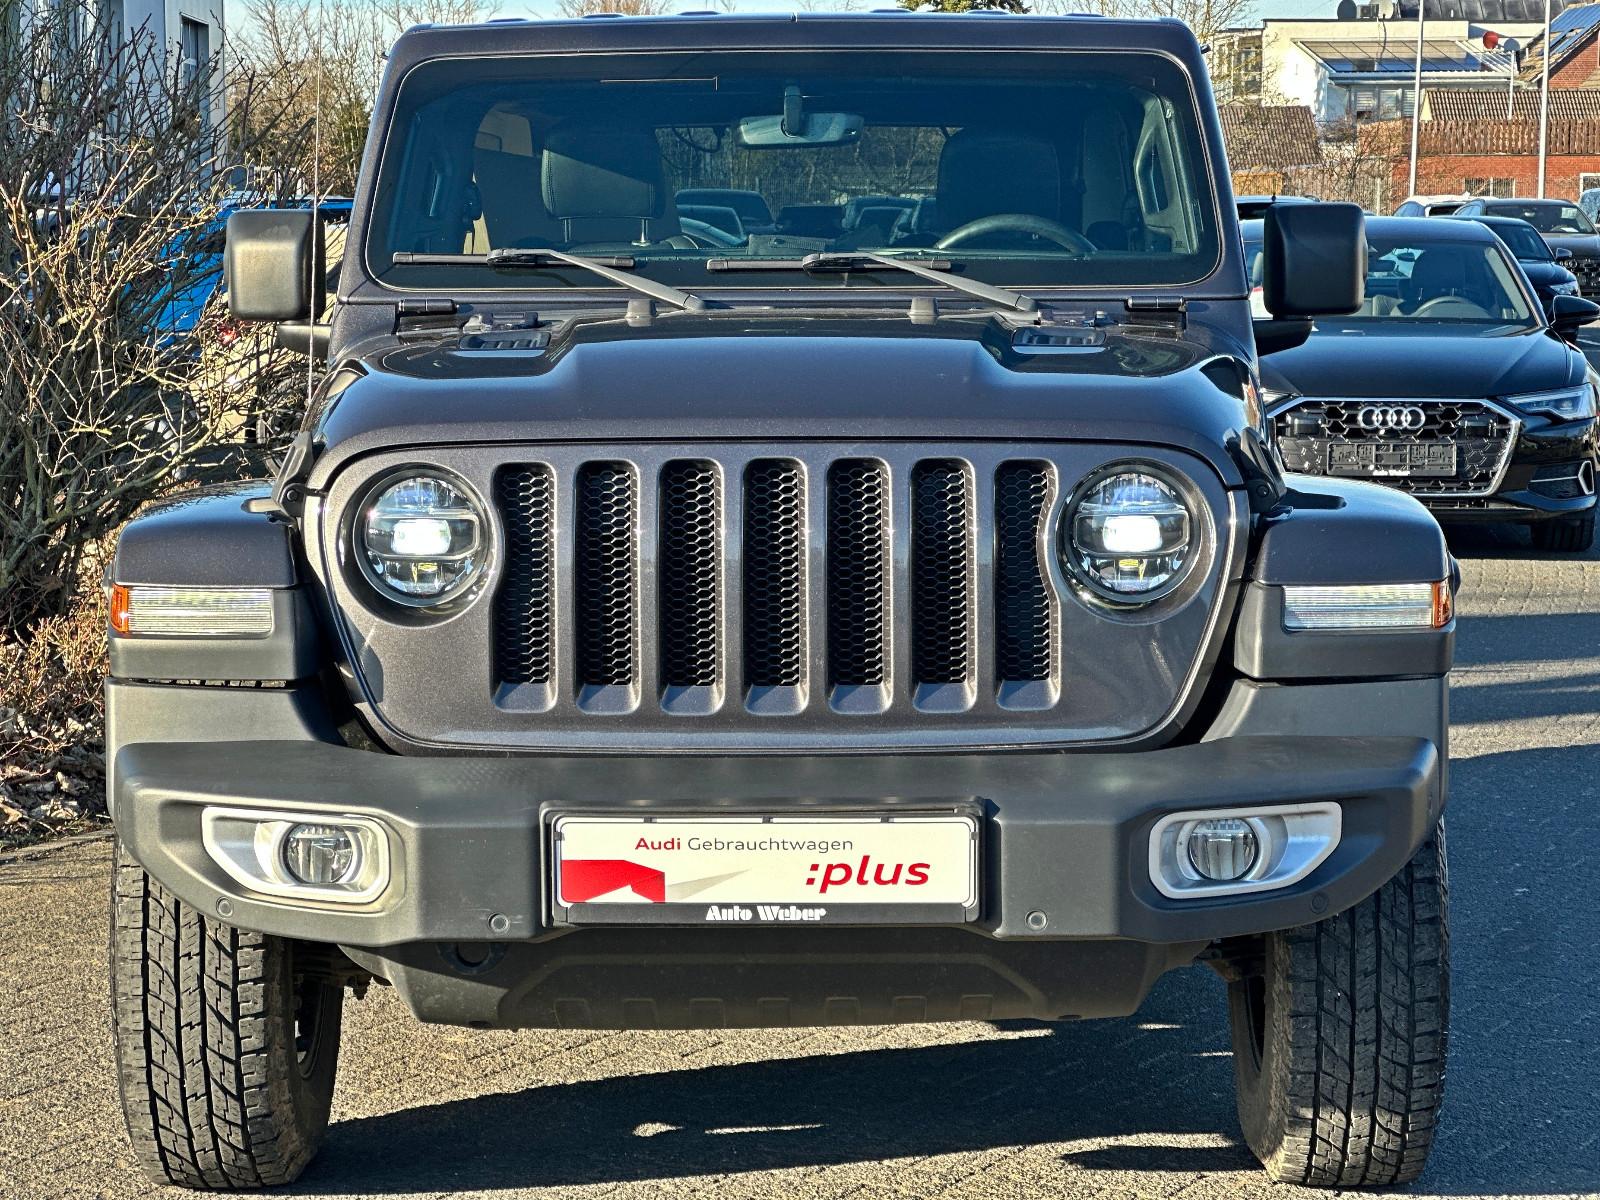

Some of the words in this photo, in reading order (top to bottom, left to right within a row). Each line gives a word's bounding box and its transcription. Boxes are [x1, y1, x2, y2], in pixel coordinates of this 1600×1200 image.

[635, 837, 681, 850] Audi
[687, 837, 853, 854] Gebrauchtwagen
[705, 905, 753, 921] Auto
[756, 905, 827, 921] Weber
